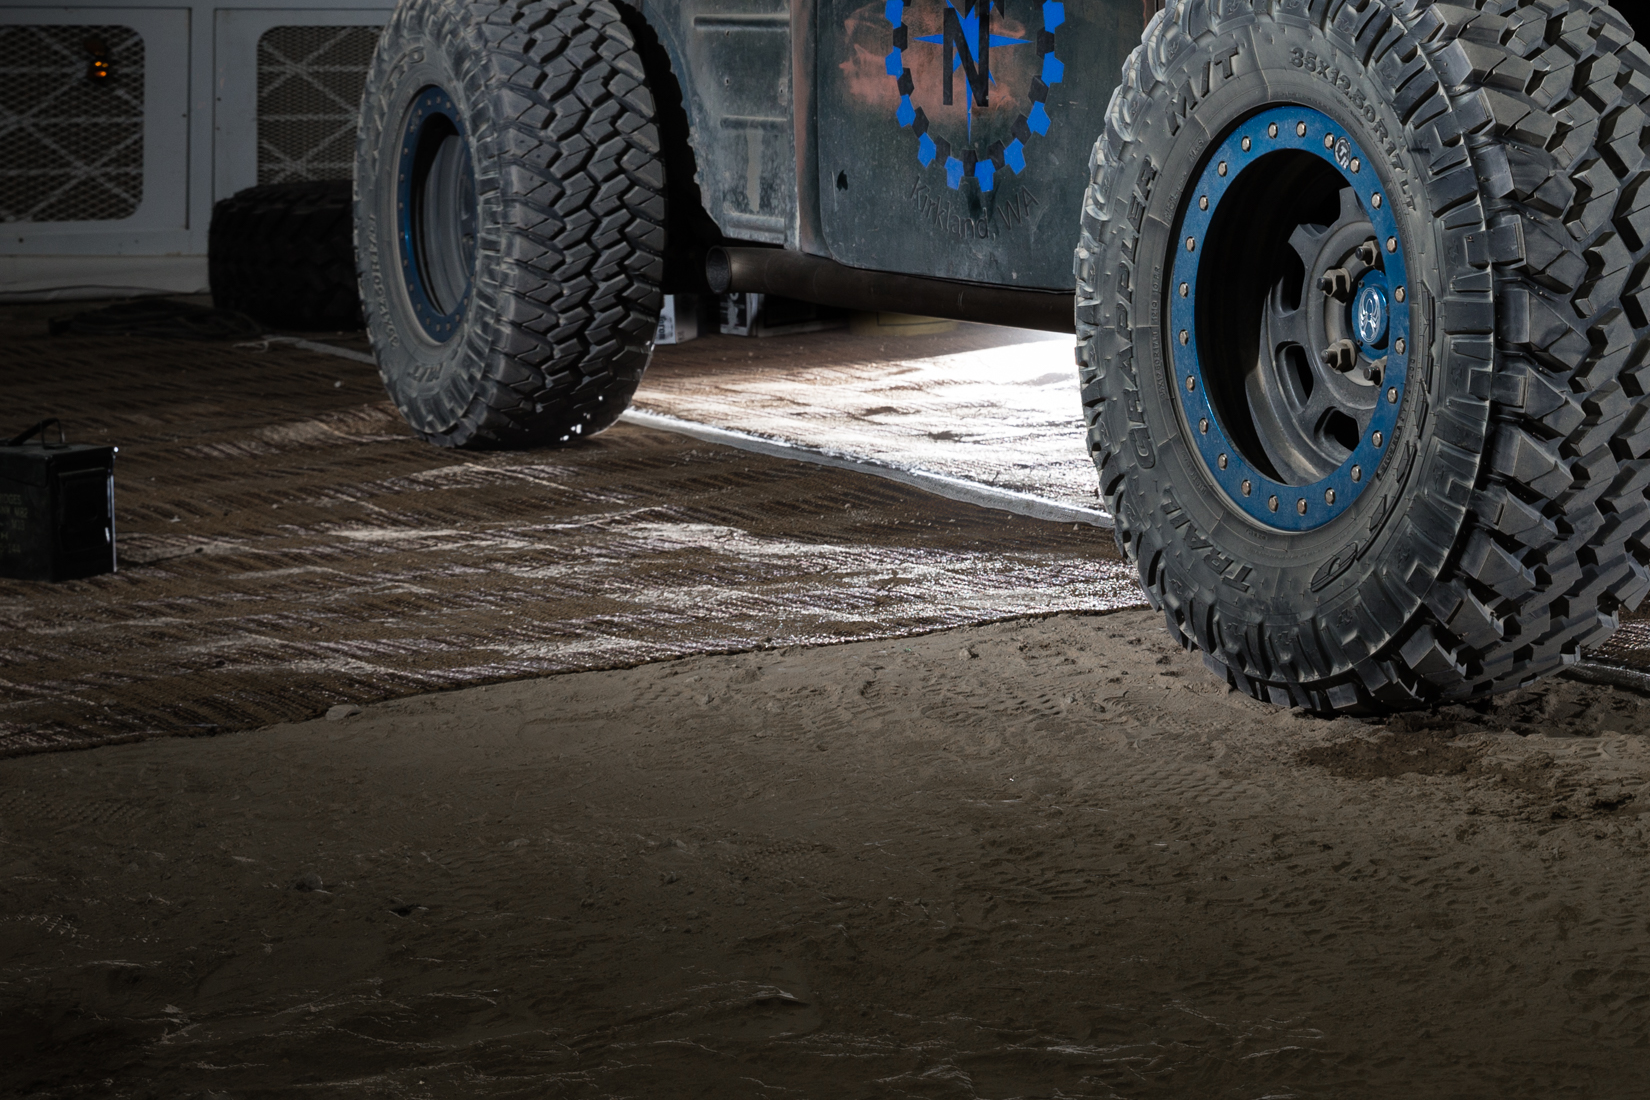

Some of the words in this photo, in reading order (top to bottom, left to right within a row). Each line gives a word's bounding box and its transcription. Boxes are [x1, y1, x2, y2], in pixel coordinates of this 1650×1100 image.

[1165, 44, 1240, 137] M/T
[910, 175, 997, 243] Kirkland,
[997, 185, 1040, 231] WA
[1116, 155, 1158, 469] GRAPPLER
[1161, 486, 1253, 593] TRAIL
